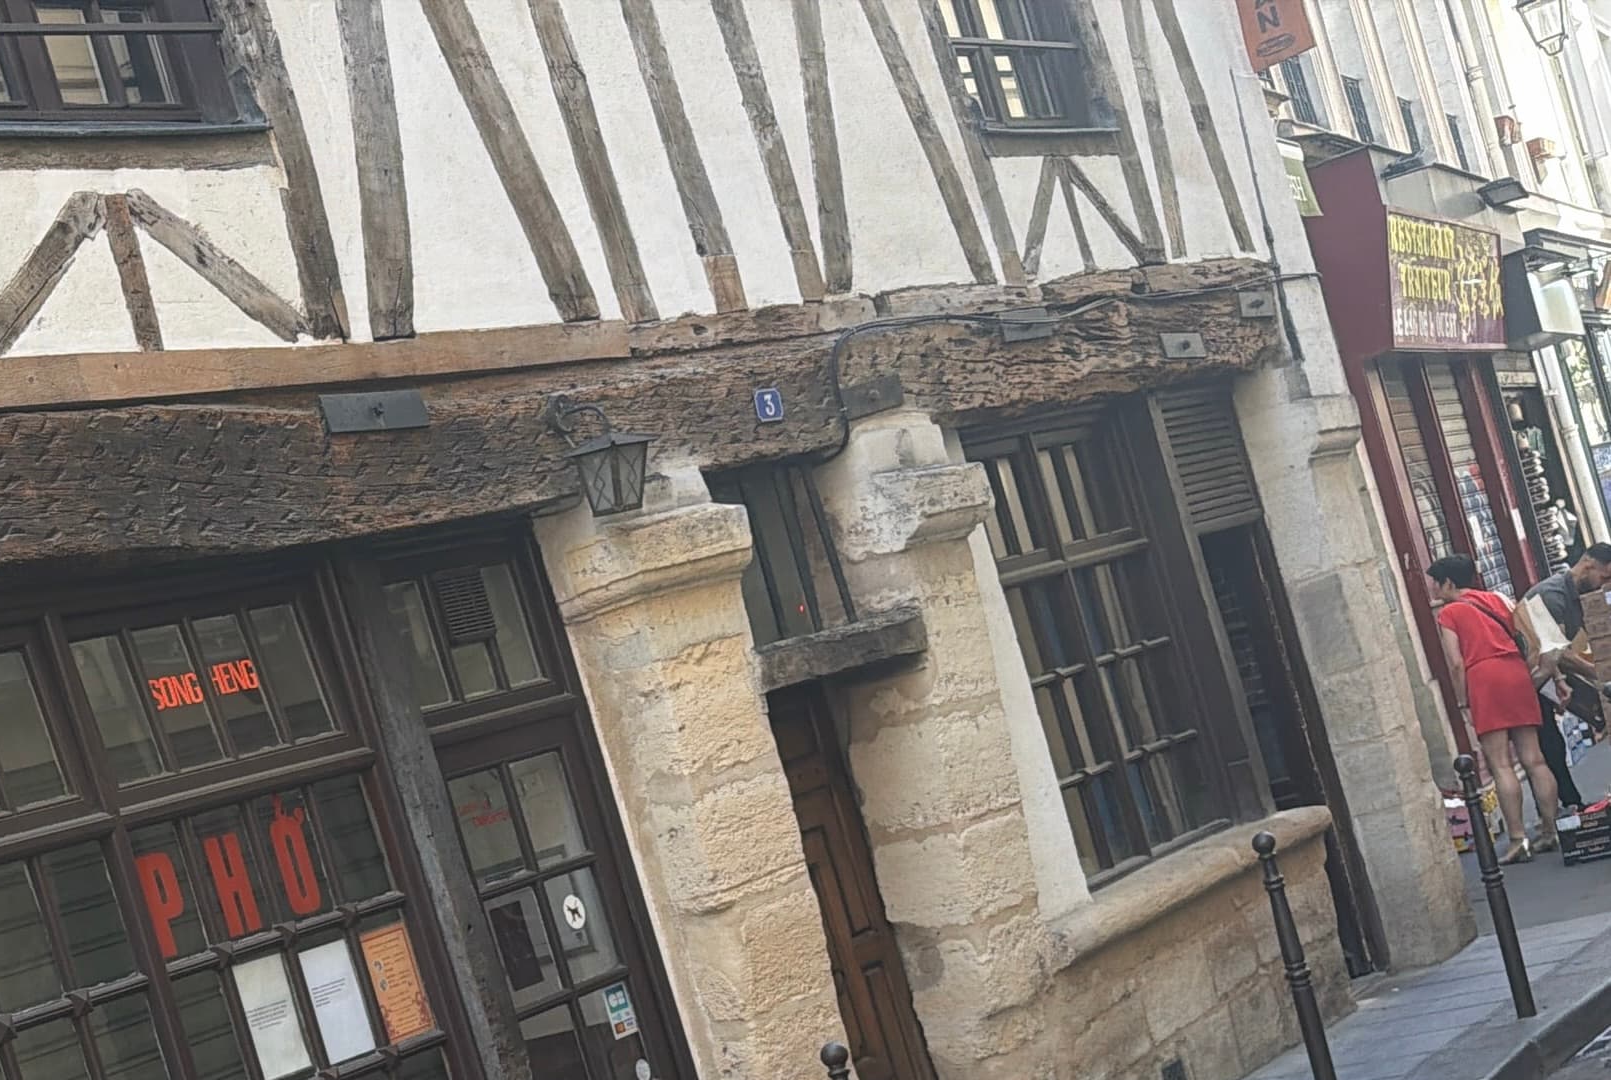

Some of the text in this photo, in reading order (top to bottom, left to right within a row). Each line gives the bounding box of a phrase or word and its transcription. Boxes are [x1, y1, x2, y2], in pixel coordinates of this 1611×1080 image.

[1398, 262, 1452, 301] TRAITEUR
[763, 393, 776, 417] 3
[148, 659, 259, 710] SONG HENG
